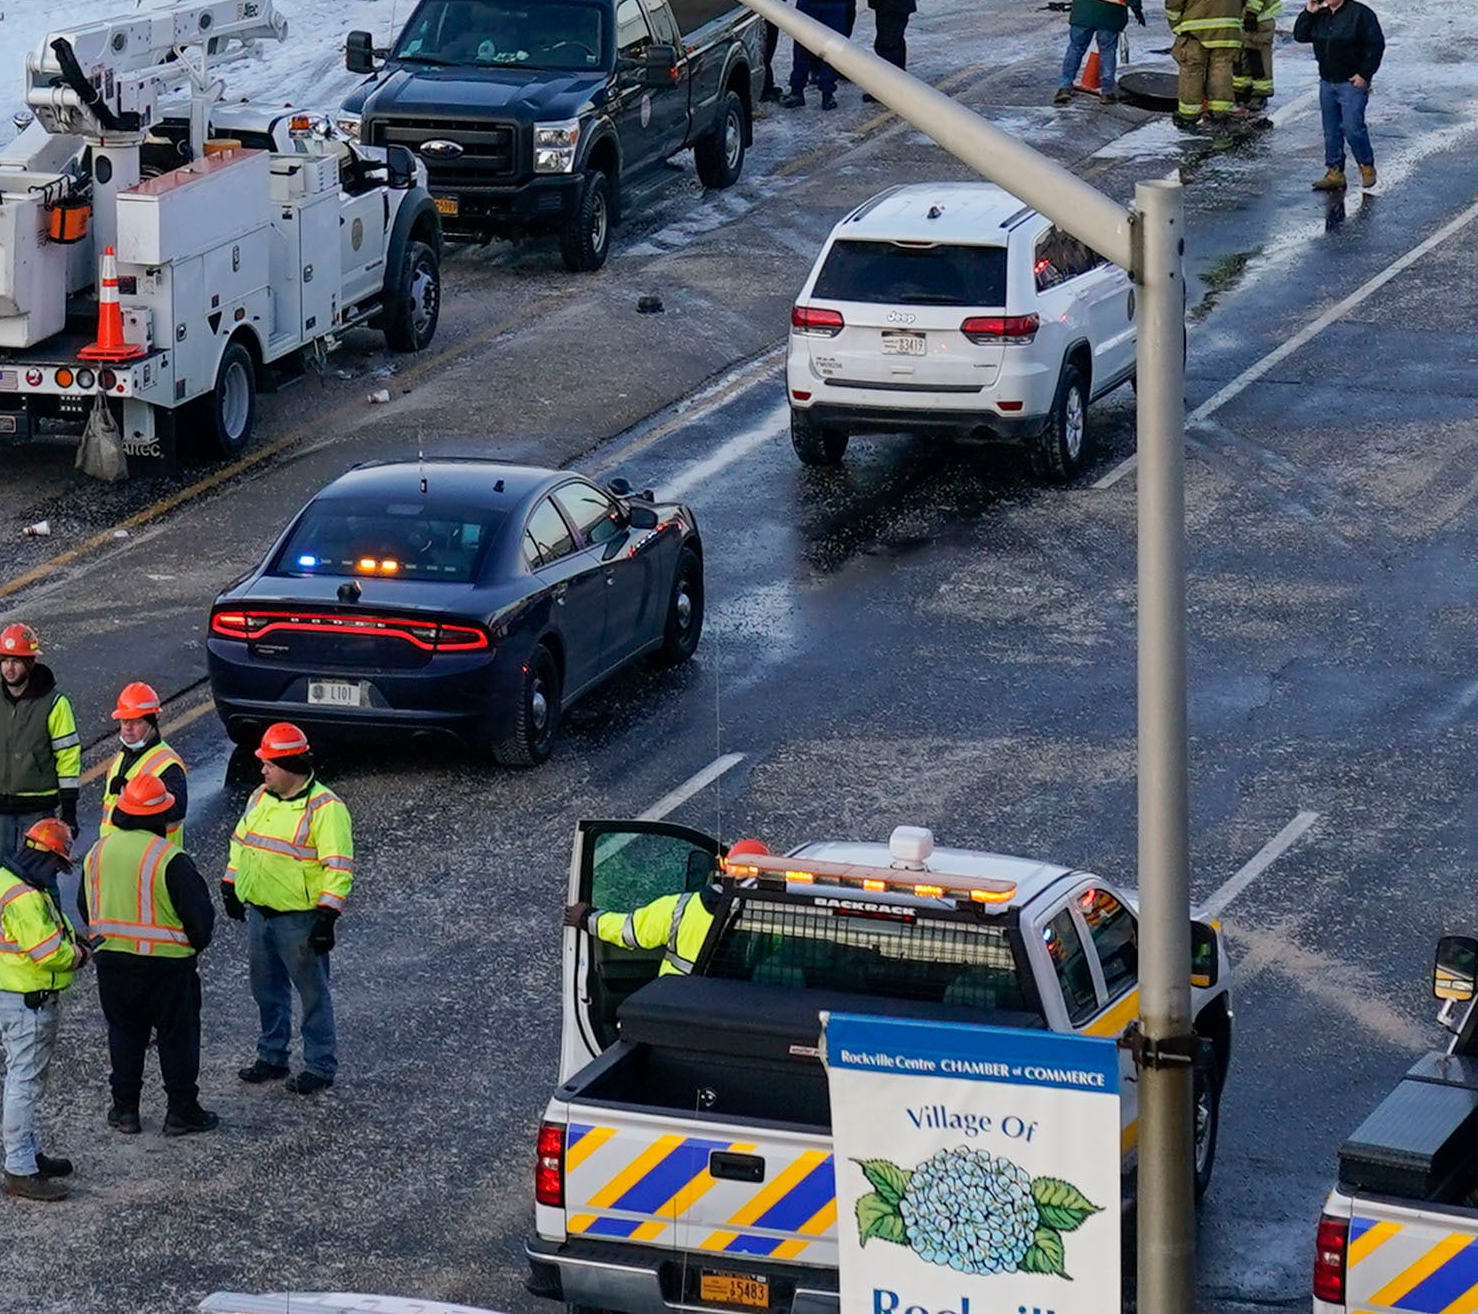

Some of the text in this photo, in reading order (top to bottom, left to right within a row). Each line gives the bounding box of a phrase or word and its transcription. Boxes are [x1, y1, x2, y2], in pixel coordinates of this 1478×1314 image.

[886, 310, 916, 324] Jeep
[814, 897, 917, 917] BACKRACK
[840, 1049, 894, 1069] Rockville
[895, 1054, 936, 1072] Centre
[940, 1059, 1010, 1077] CHAMBER
[1023, 1067, 1105, 1088] COMMERCE
[906, 1104, 1040, 1143] Village Of
